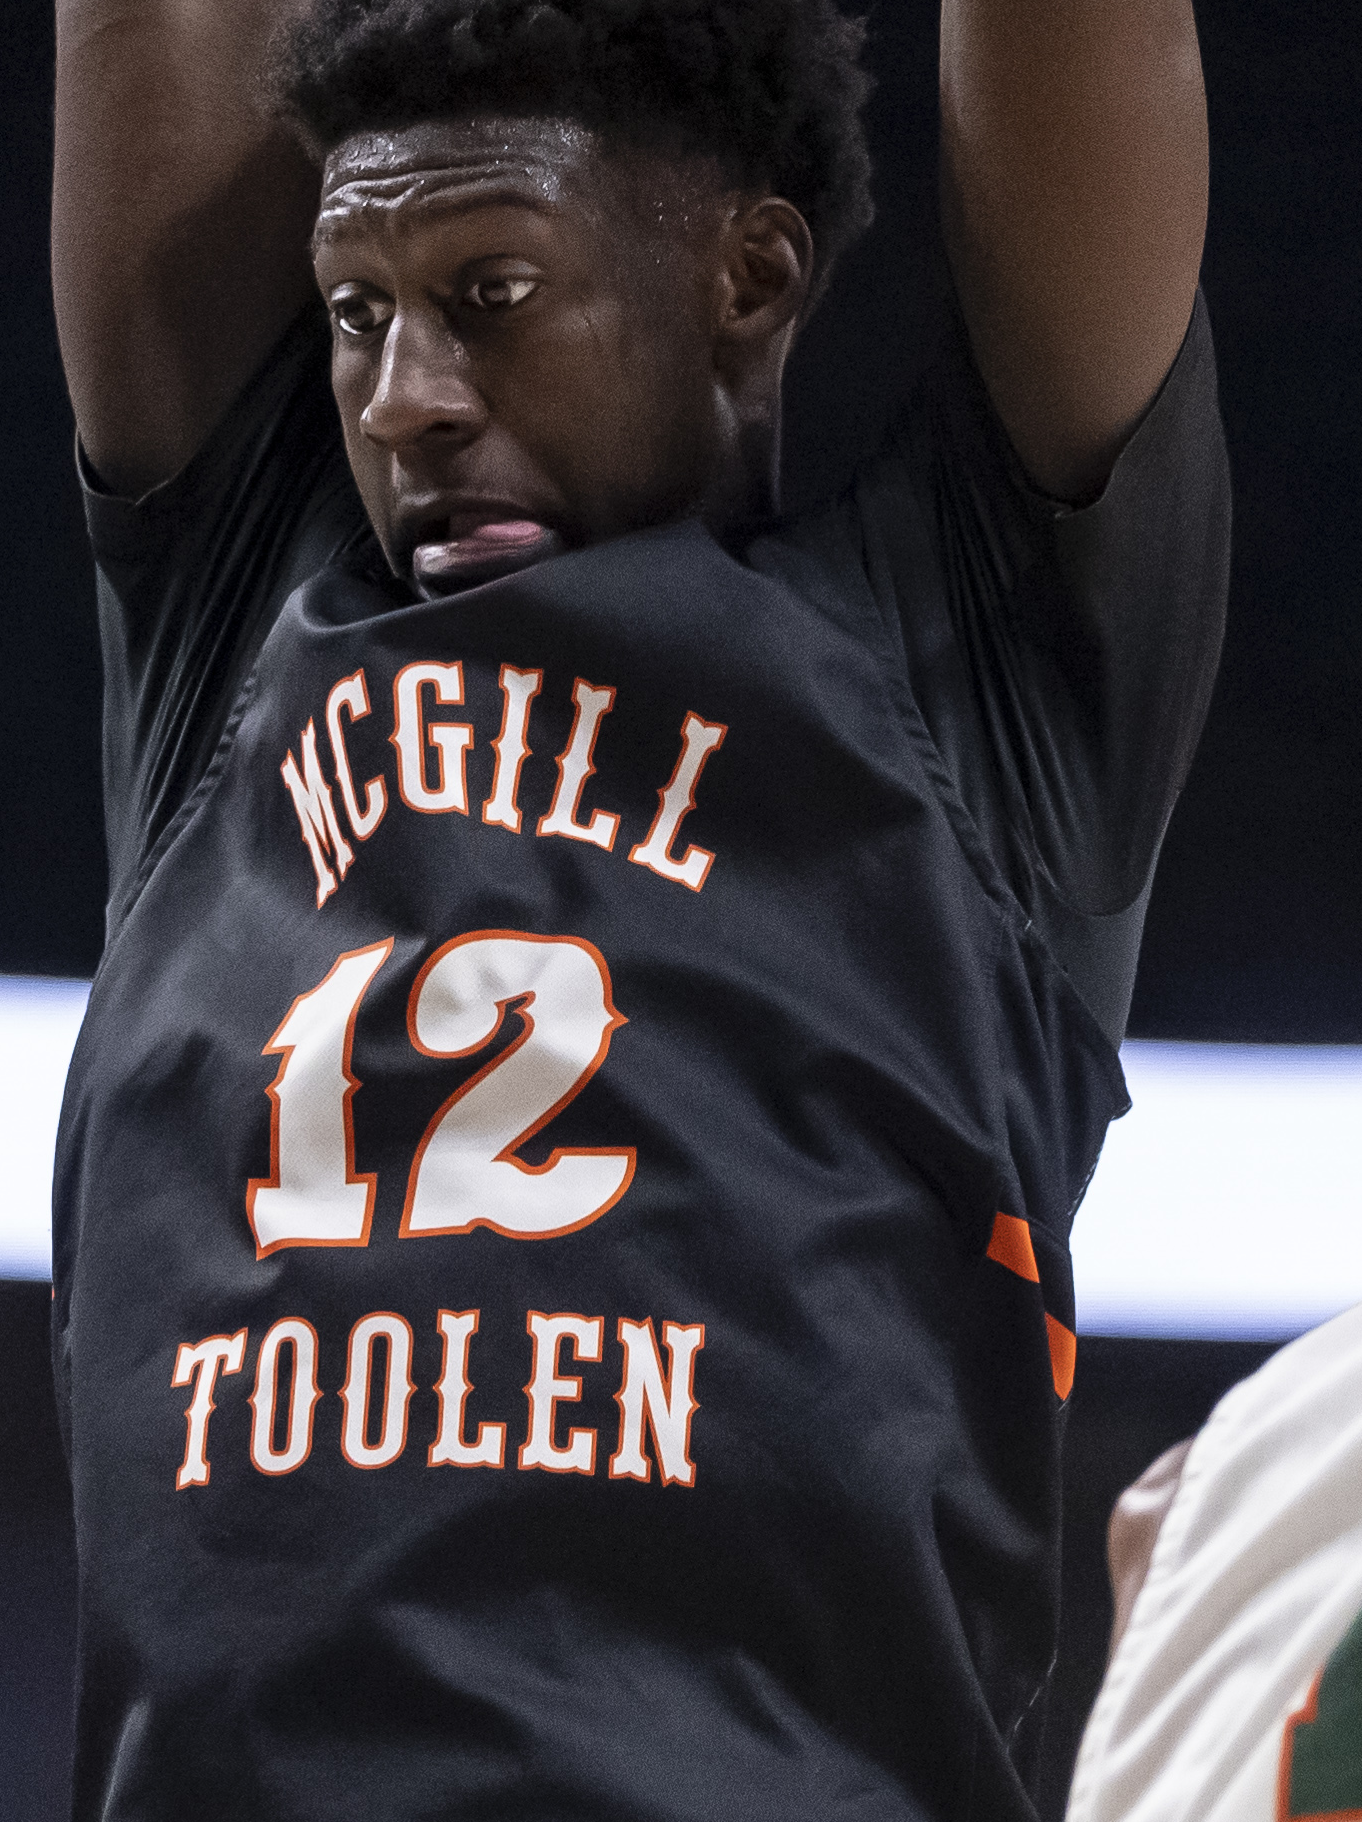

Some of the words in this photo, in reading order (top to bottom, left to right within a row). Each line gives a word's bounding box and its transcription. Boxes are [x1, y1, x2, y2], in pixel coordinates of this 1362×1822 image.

[280, 660, 729, 910] MCGILL
[246, 928, 630, 1260] 12
[171, 1307, 706, 1490] TOOLEN
